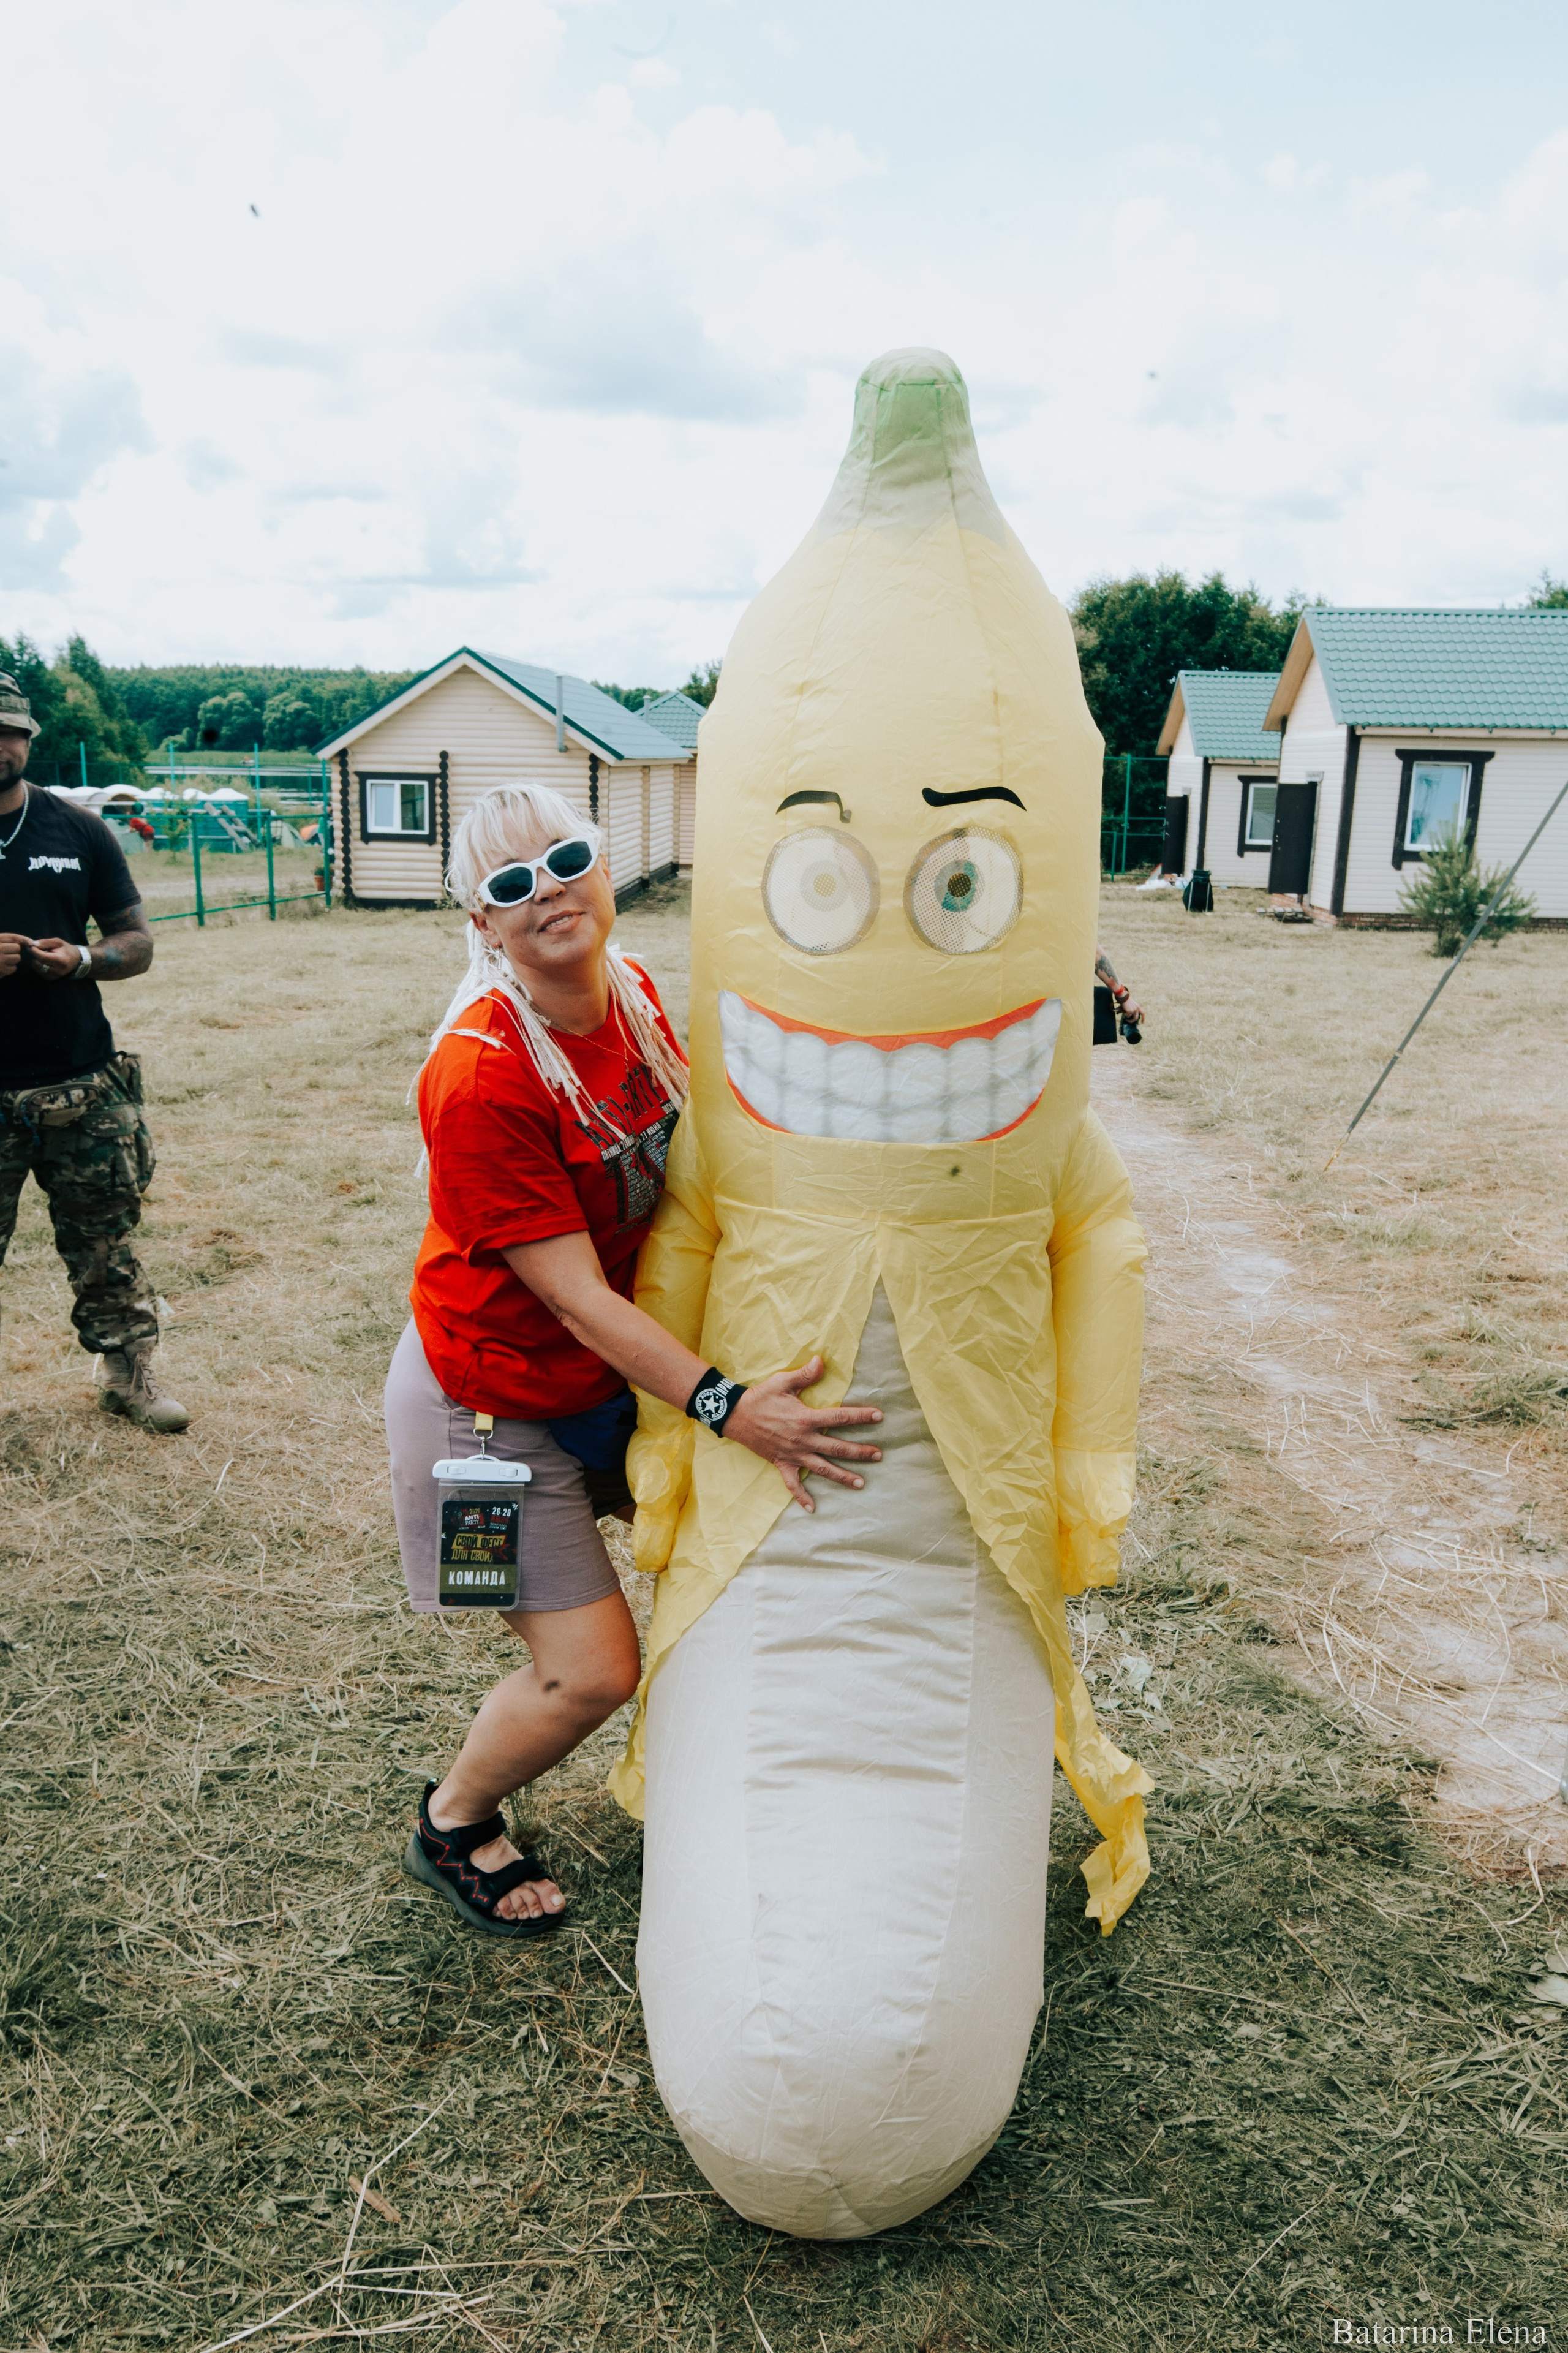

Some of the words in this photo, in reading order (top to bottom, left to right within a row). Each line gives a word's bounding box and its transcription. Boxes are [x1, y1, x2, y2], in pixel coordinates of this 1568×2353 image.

[456, 1535, 478, 1548] СВОЙ
[481, 1537, 503, 1549] ФЕСТ
[451, 1549, 469, 1560] ДЛЯ
[448, 1571, 505, 1585] КОМАНДА
